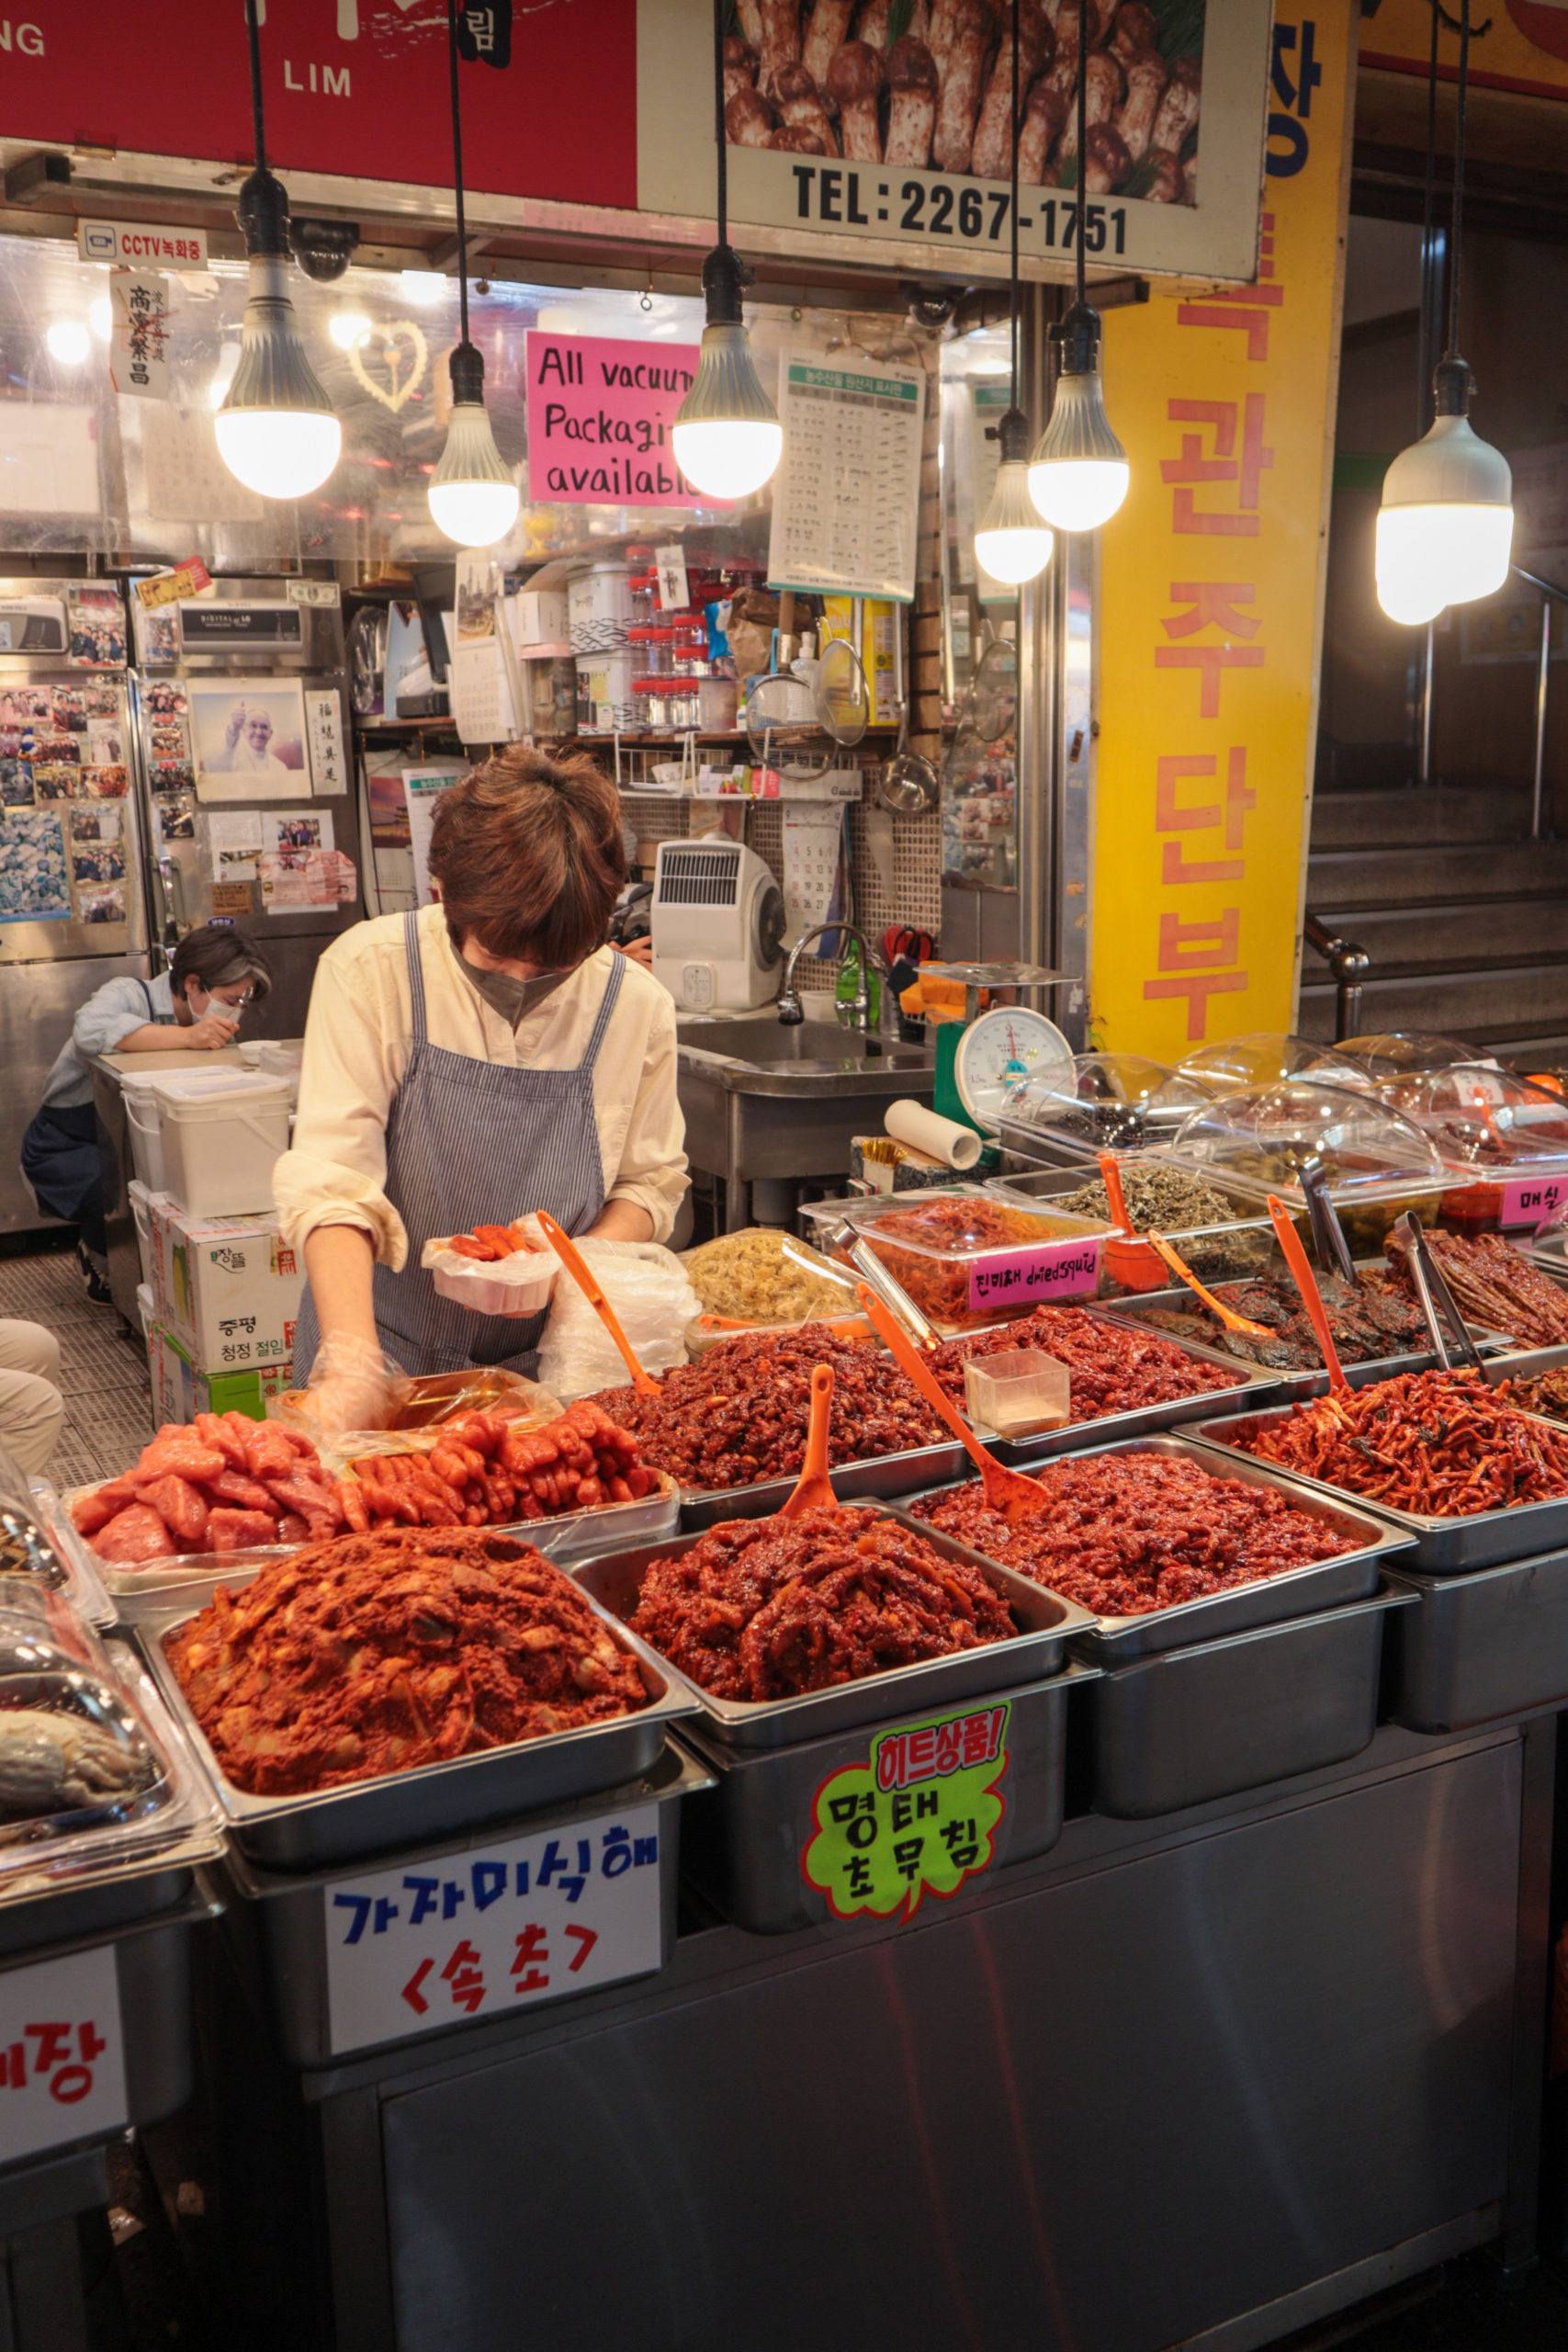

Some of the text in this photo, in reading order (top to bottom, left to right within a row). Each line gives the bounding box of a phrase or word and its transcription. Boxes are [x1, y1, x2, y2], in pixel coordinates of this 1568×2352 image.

[466, 7, 494, 51] 림
[284, 60, 351, 97] LIM
[538, 347, 583, 387] All
[1520, 1186, 1562, 1210] 매실
[219, 1316, 256, 1336] 증평
[878, 1708, 1004, 1789] 히트상품!
[333, 1826, 658, 1944] 가자미식해
